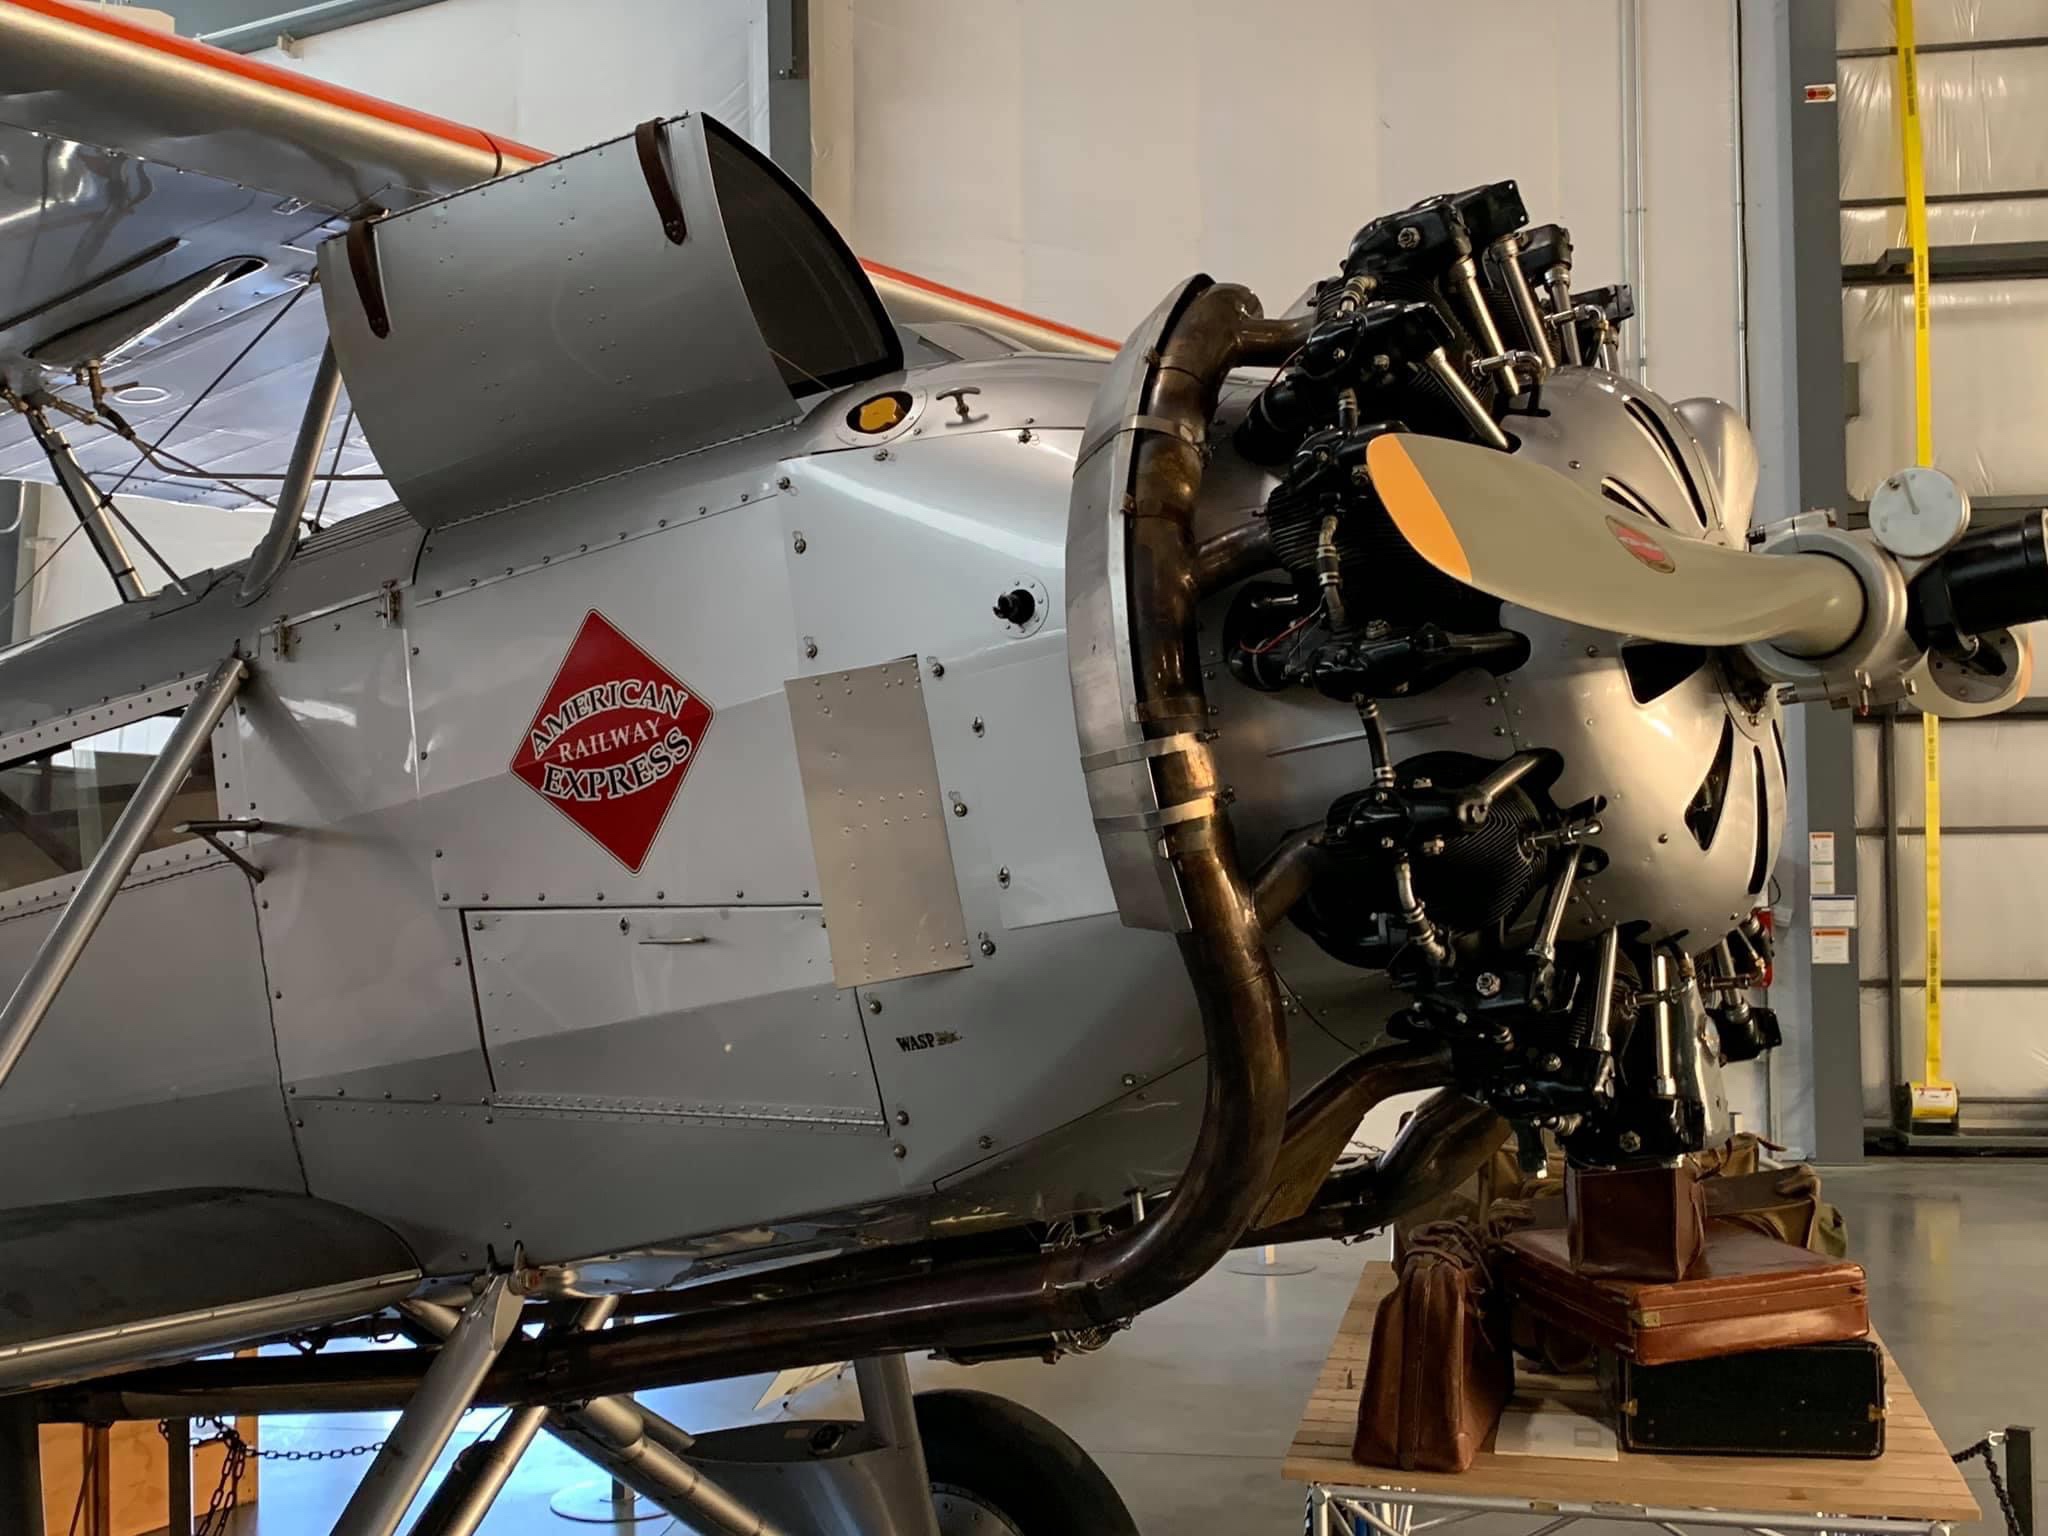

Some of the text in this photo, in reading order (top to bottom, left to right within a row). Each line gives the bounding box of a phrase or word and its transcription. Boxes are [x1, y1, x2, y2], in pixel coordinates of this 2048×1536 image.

[531, 680, 687, 759] AMERICAN
[559, 718, 661, 763] RAILWAY
[542, 727, 691, 801] EXPRESS
[897, 1033, 934, 1052] WASP
